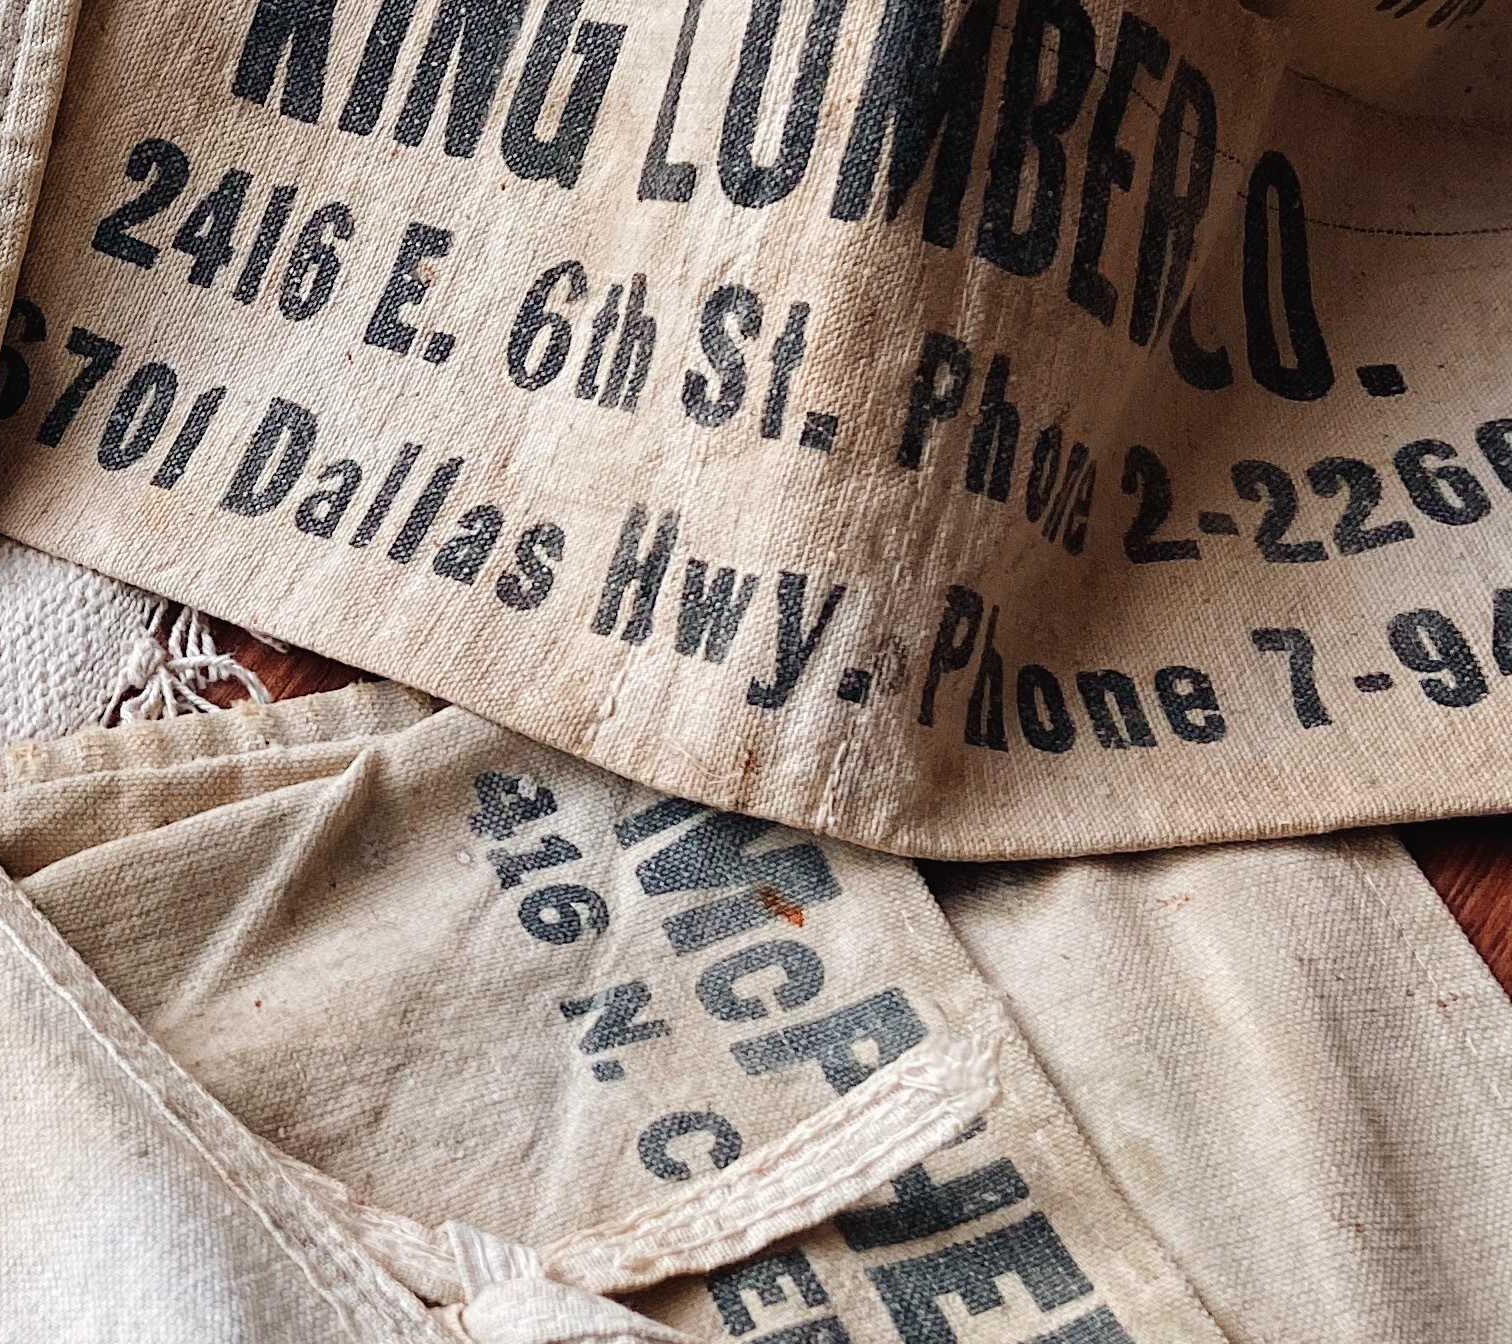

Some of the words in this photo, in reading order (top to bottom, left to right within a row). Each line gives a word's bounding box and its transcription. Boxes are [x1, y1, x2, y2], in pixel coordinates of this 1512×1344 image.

[90, 136, 356, 323] 2416
[363, 222, 456, 366] E.
[505, 259, 661, 412] 6th
[682, 281, 838, 453] St.
[897, 330, 1098, 558] Phone
[219, 396, 567, 613] Dallas
[592, 499, 872, 711] Hwy.
[917, 584, 1227, 756] Phone
[1249, 587, 1512, 730] 7-9
[466, 770, 611, 946] 416
[559, 978, 673, 1083] N.
